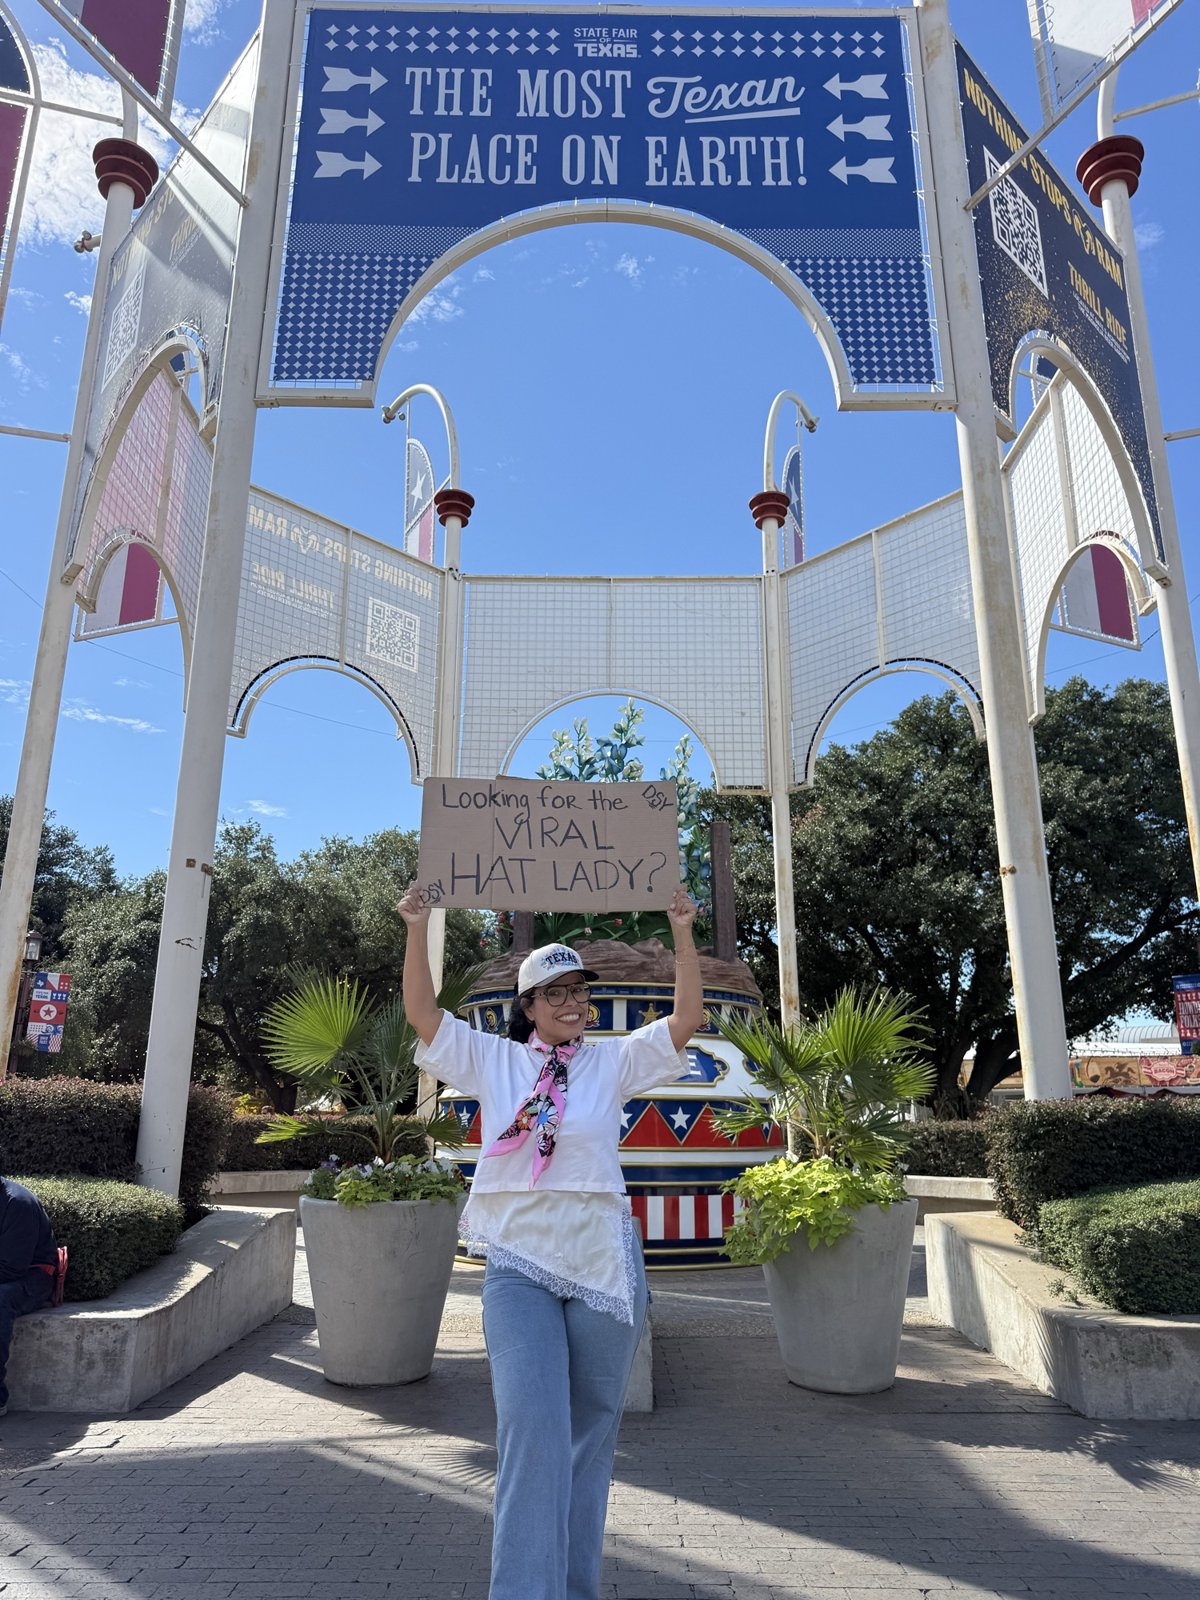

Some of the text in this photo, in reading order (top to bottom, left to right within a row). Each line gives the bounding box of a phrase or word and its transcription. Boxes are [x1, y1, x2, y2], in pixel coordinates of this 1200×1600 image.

[573, 27, 638, 39] STATE FAIR
[573, 43, 638, 58] TEXAS
[404, 66, 806, 119] THE MOST Texan
[407, 132, 808, 187] PLACE ON EARTH!
[1029, 153, 1072, 225] STOPS
[1095, 236, 1124, 291] RAM
[1067, 260, 1104, 322] THRILL
[1104, 306, 1128, 352] RIDE
[442, 783, 530, 825] Looking
[588, 788, 628, 811] the
[495, 815, 615, 850] VIRAL
[451, 851, 667, 895] HAT LADY?
[545, 951, 578, 965] TEXAS
